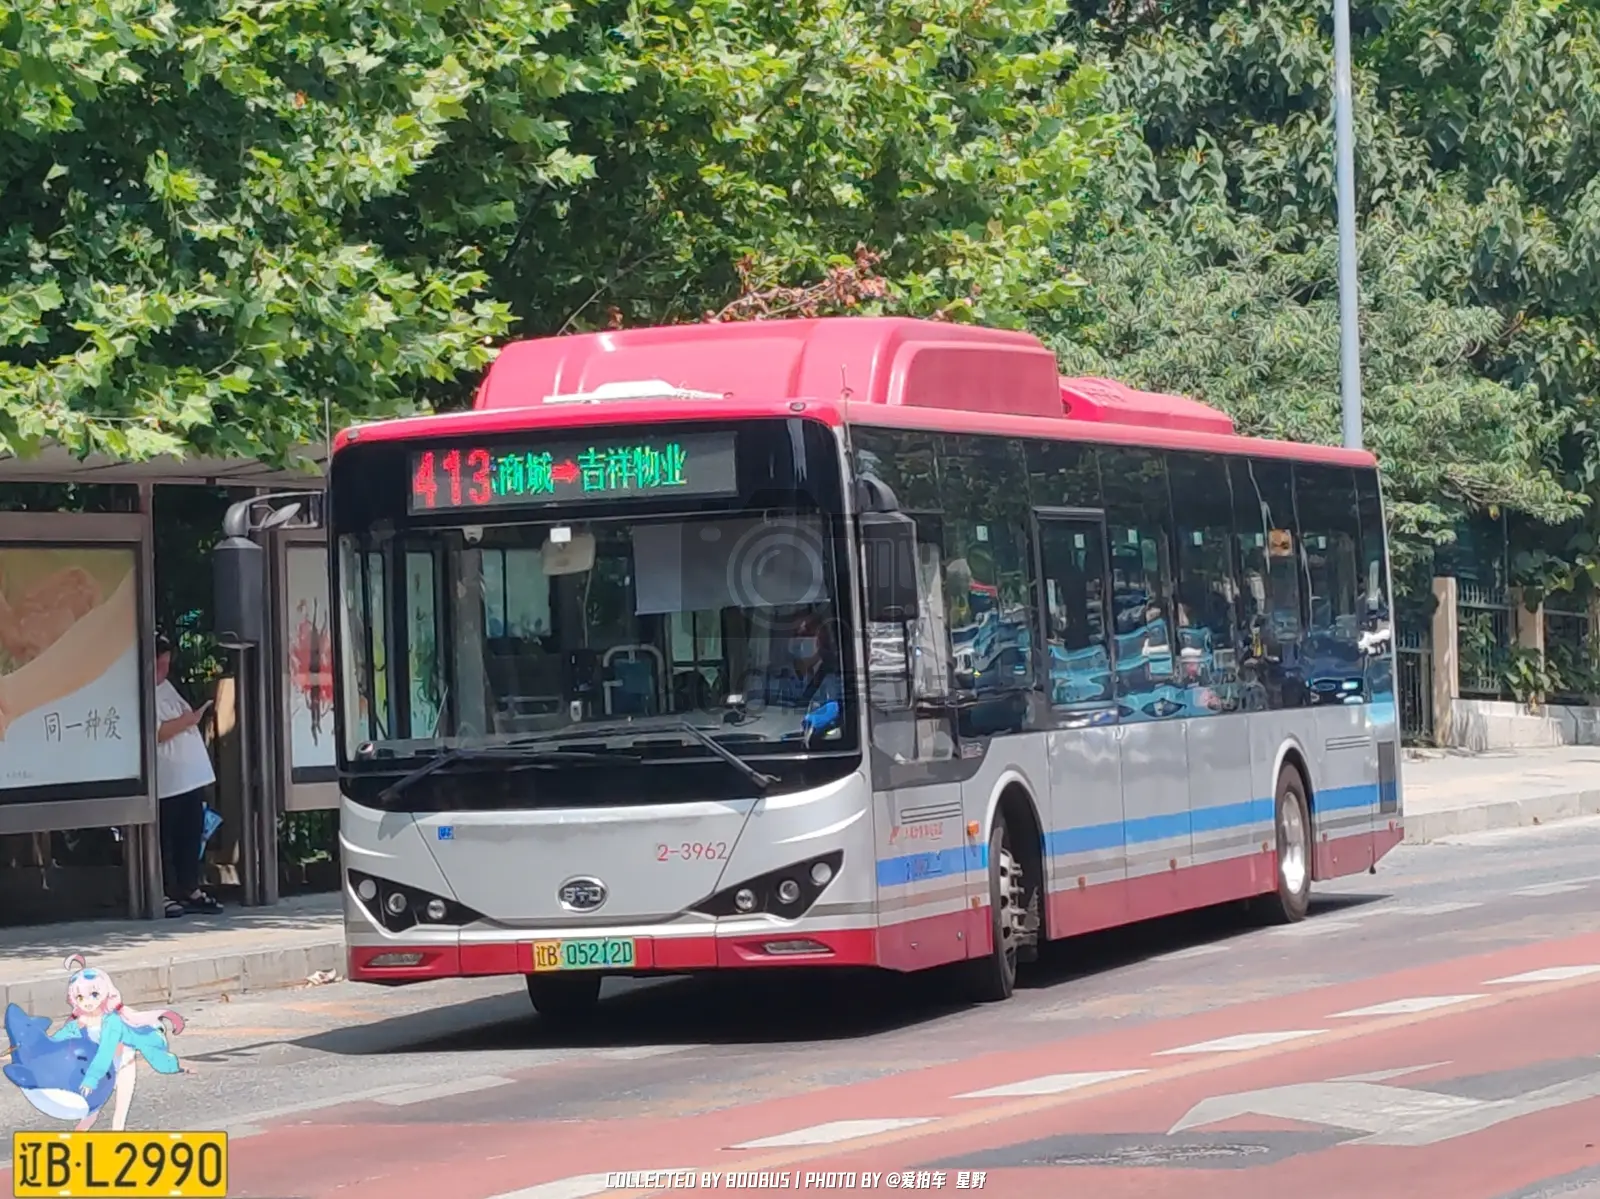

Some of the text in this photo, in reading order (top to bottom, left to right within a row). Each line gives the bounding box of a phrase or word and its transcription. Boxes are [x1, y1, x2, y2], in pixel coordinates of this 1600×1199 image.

[412, 449, 492, 508] 413
[493, 443, 687, 495] 商城 吉祥物业
[44, 706, 122, 742] 同一种爱
[656, 841, 727, 862] 2-3962
